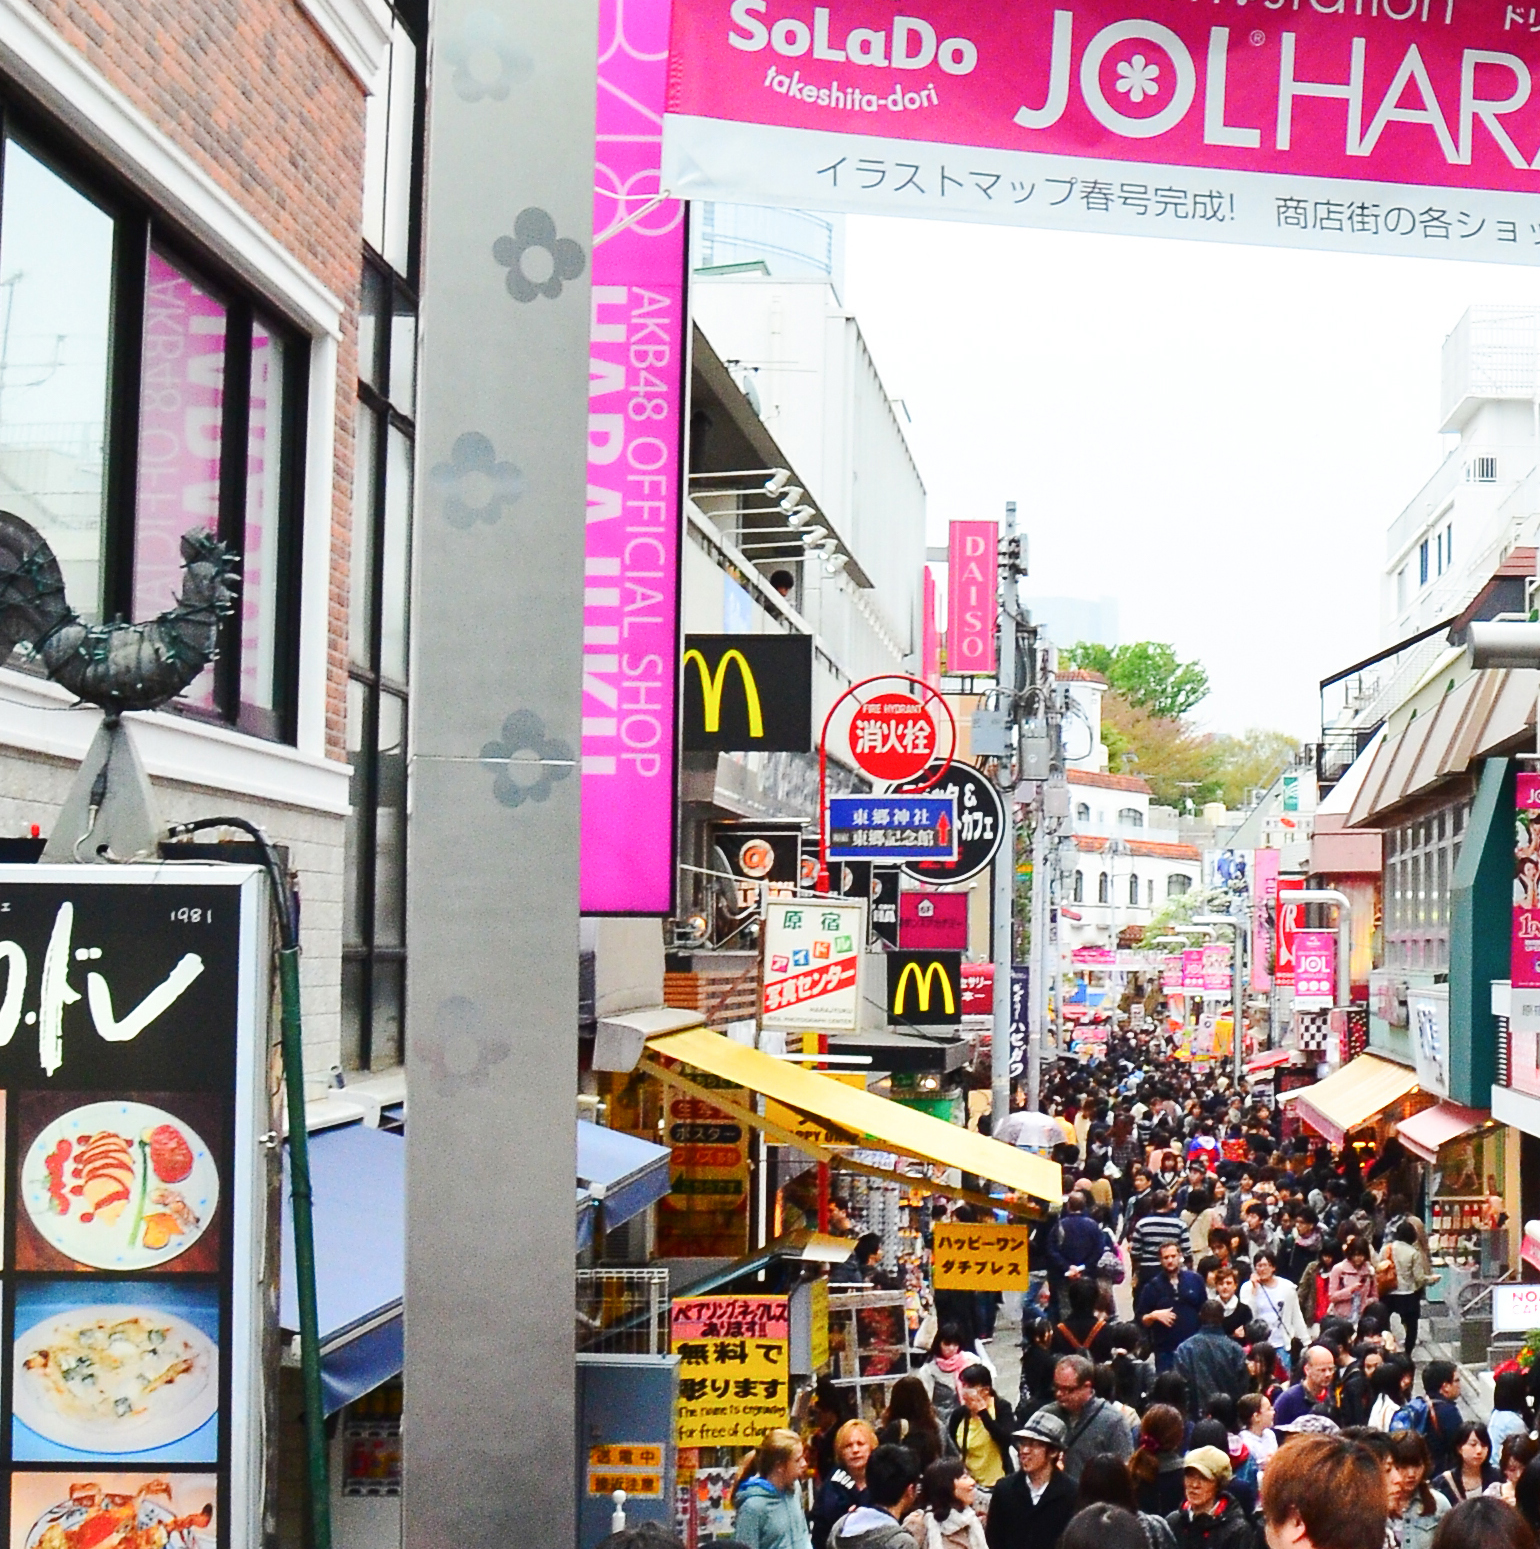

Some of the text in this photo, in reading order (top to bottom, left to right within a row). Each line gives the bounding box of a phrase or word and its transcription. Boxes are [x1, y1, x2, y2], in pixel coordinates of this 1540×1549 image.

[763, 65, 939, 114] takeshita-dori
[817, 156, 1236, 223] イラストマップ春号完成!
[620, 286, 671, 778] AKB48 OFFICIAL SHOP
[961, 534, 985, 659] DAISO
[862, 703, 923, 714] FIRE HYDRANT
[855, 718, 932, 755] 消火栓
[851, 807, 932, 826] 東郷神社
[851, 829, 935, 848] 東郷記念館
[170, 907, 213, 923] 1981
[783, 910, 842, 932] 原宿
[771, 934, 853, 974] アイドル
[765, 964, 856, 1010] 写真センター
[937, 1235, 1025, 1252] ハッピーワン
[677, 1340, 783, 1366] 無料で
[679, 1377, 786, 1402] 彫ります
[700, 1423, 726, 1440] free
[728, 1422, 741, 1438] of
